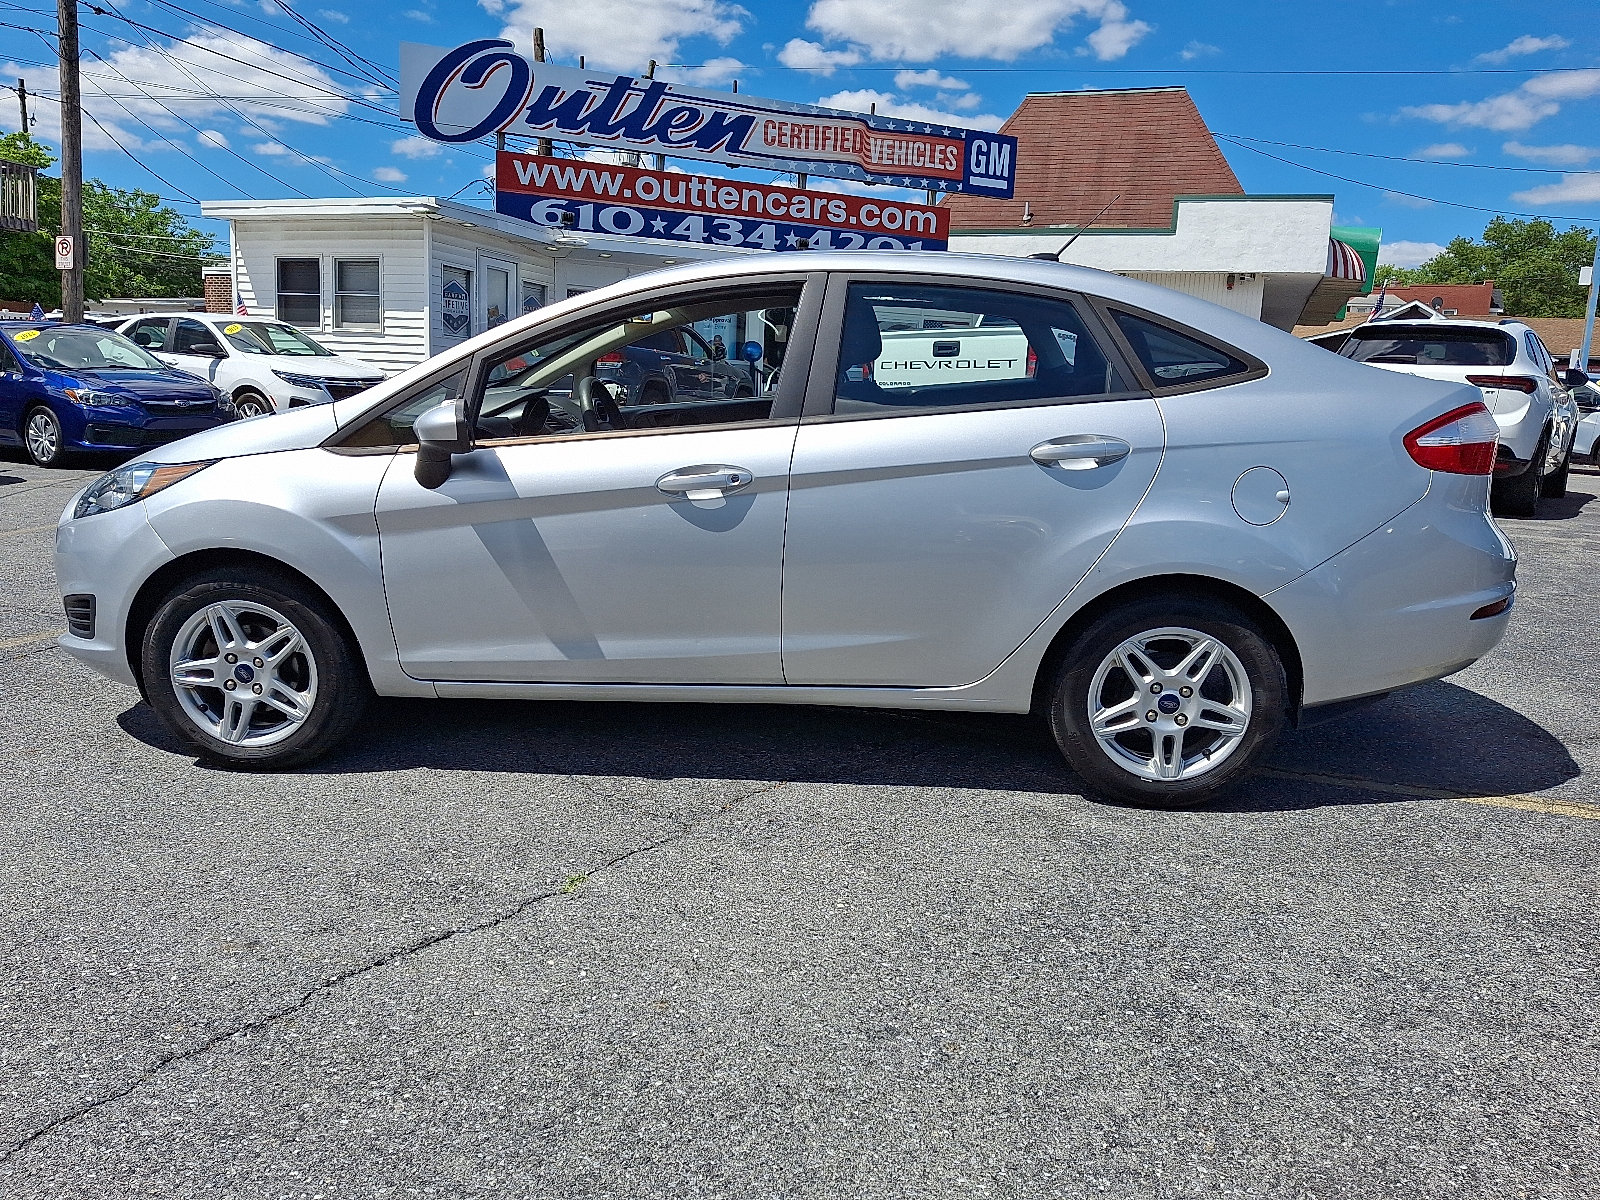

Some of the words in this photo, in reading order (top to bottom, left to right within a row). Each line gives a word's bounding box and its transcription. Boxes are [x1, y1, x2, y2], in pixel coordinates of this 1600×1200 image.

[414, 39, 758, 155] Outten
[763, 119, 863, 153] CERTIFIED
[870, 136, 958, 171] VEHICLES
[970, 139, 1011, 178] GM
[513, 159, 937, 234] www.outtencars.com
[880, 358, 1018, 370] CHEVROLET
